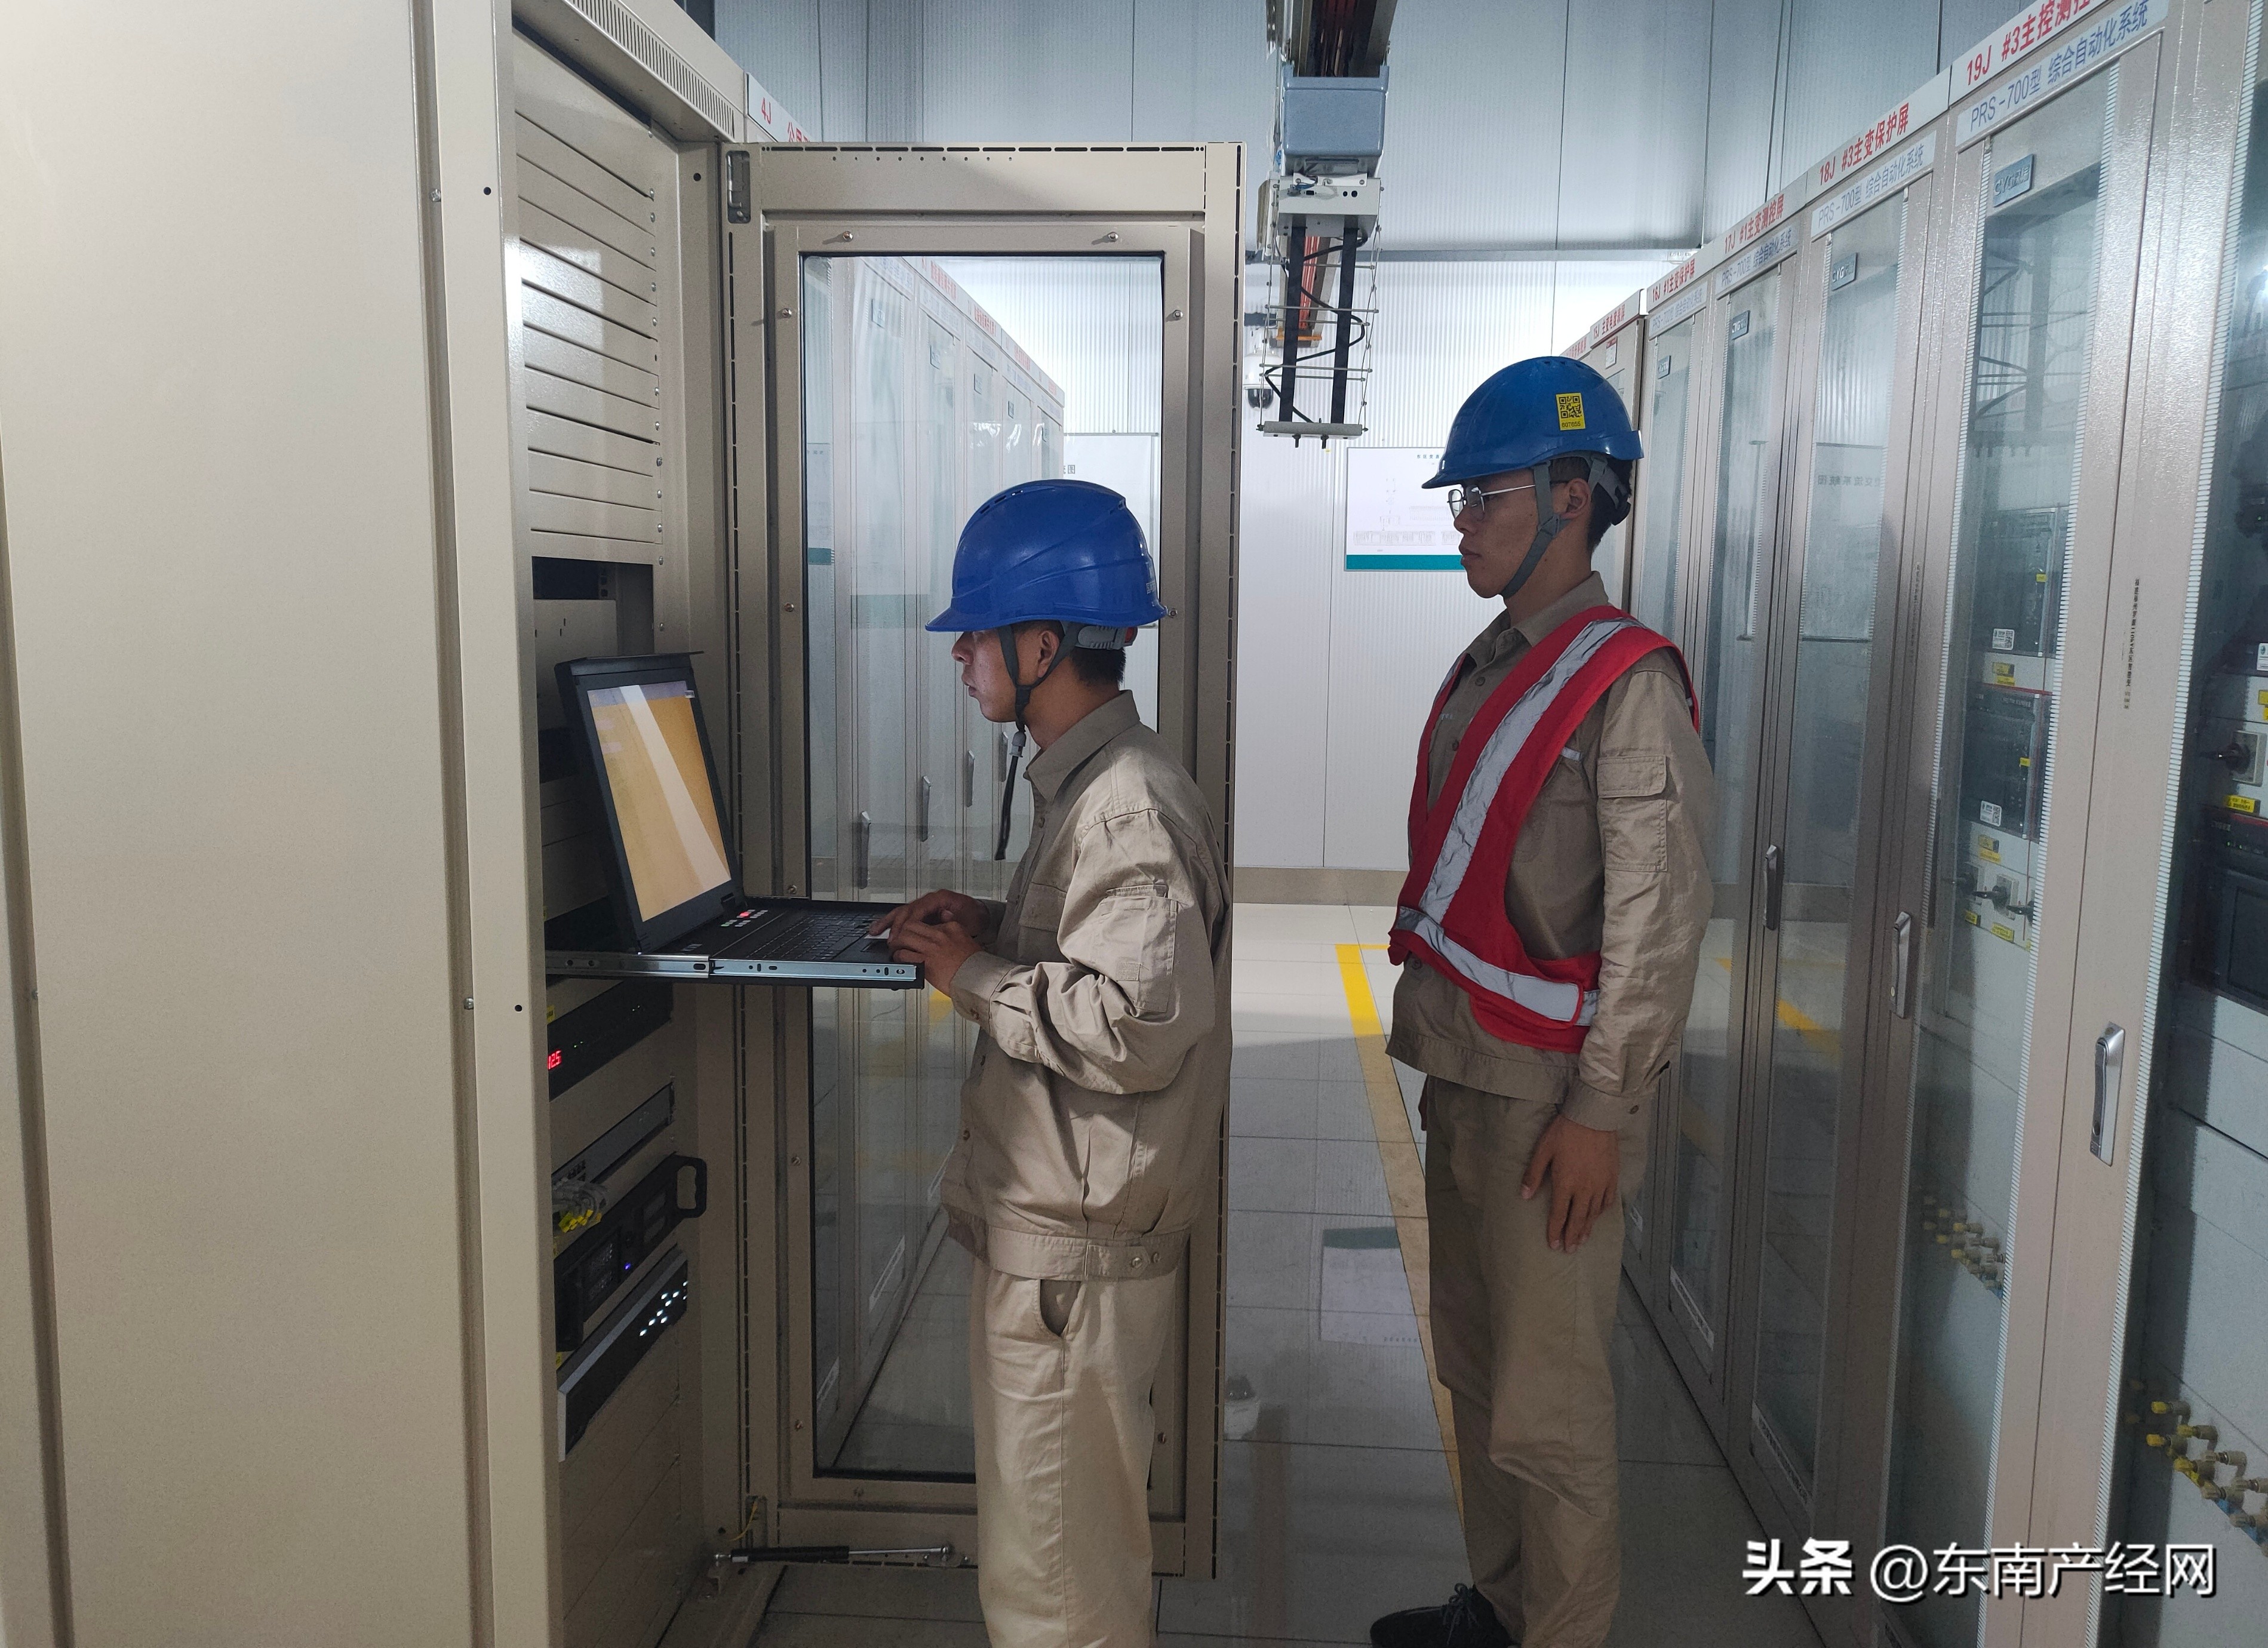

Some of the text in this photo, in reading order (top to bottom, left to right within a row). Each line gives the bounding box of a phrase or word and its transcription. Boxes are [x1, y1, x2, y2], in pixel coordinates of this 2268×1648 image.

[1967, 45, 1992, 85] 19J
[1971, 0, 2148, 132] PRS-700型 综合自动化系统
[761, 97, 772, 125] 4J
[1820, 102, 1909, 186] 18J #3主变保护屏
[1818, 143, 1924, 228] PRS-700型 综合自动化系统
[1725, 230, 1735, 254] 17J
